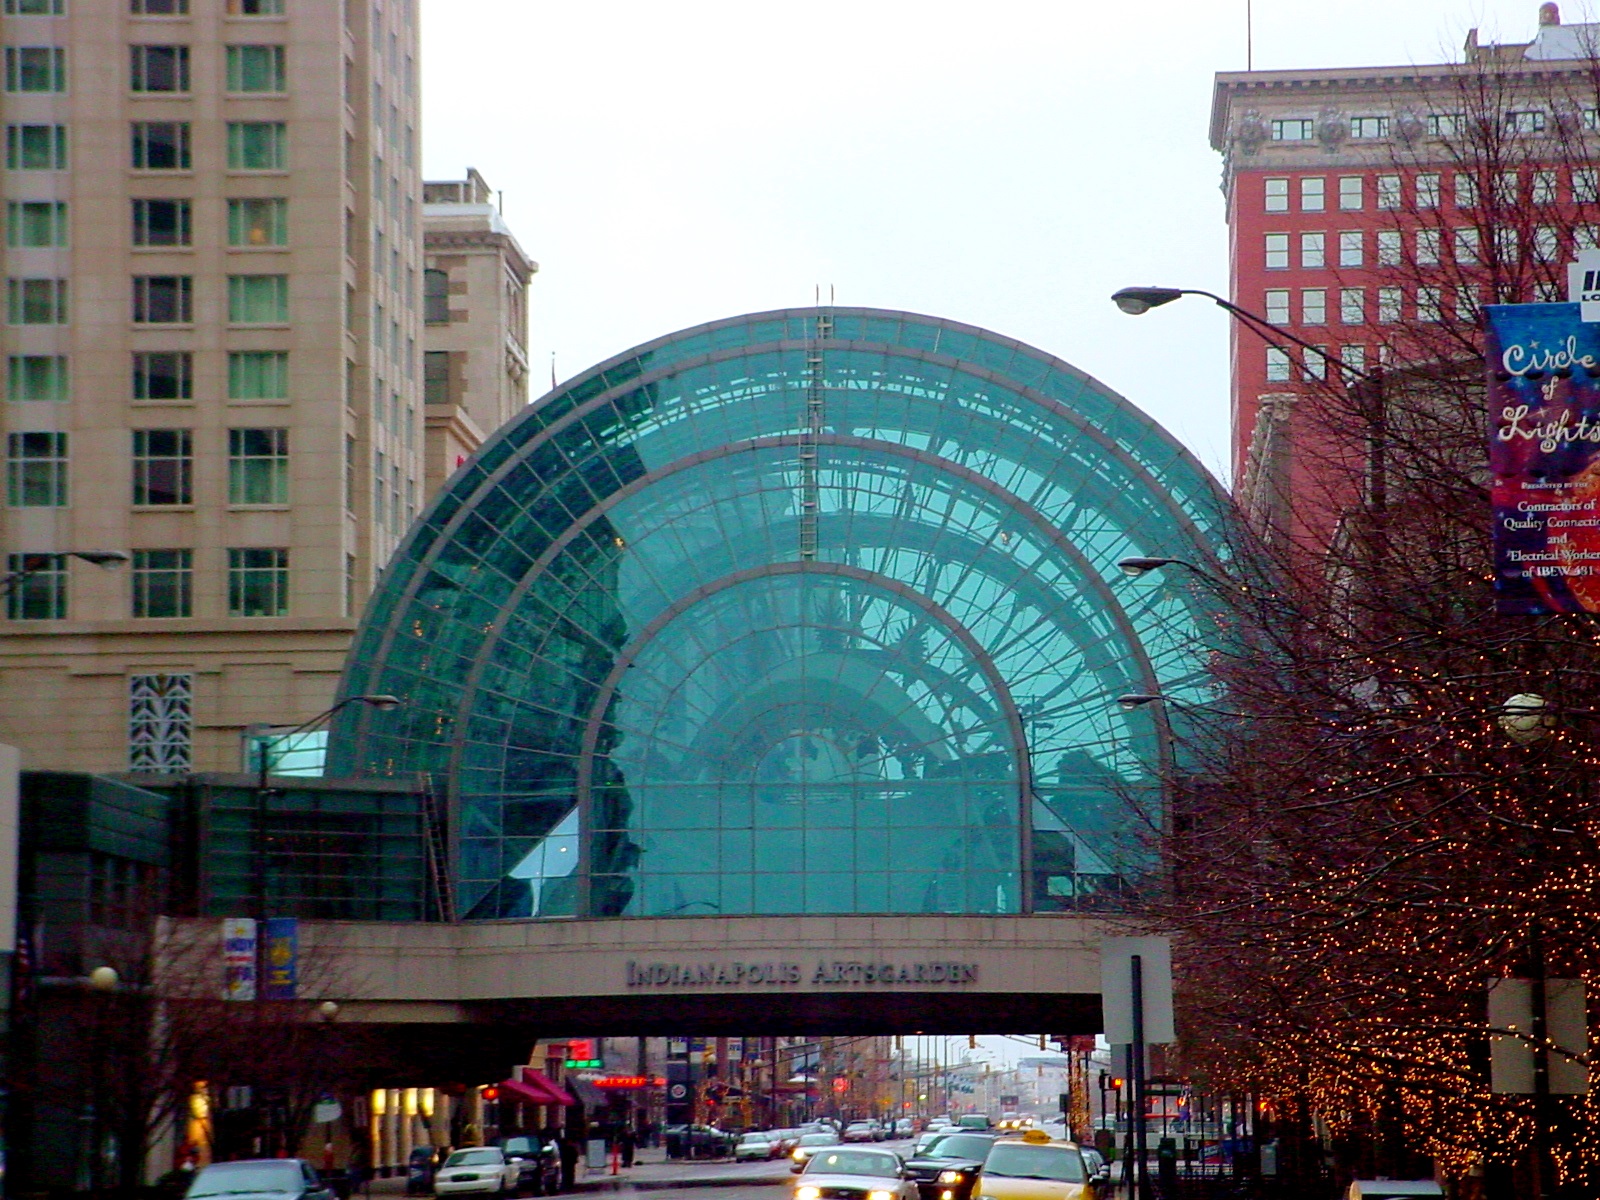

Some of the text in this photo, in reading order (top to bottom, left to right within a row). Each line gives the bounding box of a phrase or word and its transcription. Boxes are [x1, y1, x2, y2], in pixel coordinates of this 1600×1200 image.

[1503, 335, 1597, 375] Circle
[1541, 376, 1559, 400] of
[1499, 405, 1600, 453] Lights
[1517, 499, 1597, 512] Contractors of
[1503, 517, 1544, 531] Quality
[1547, 532, 1567, 544] and
[1511, 549, 1558, 562] Electrical
[1522, 566, 1535, 578] of
[1537, 566, 1570, 577] IBEW
[627, 959, 979, 987] INDIANAPOLIS ARTSGARDEN
